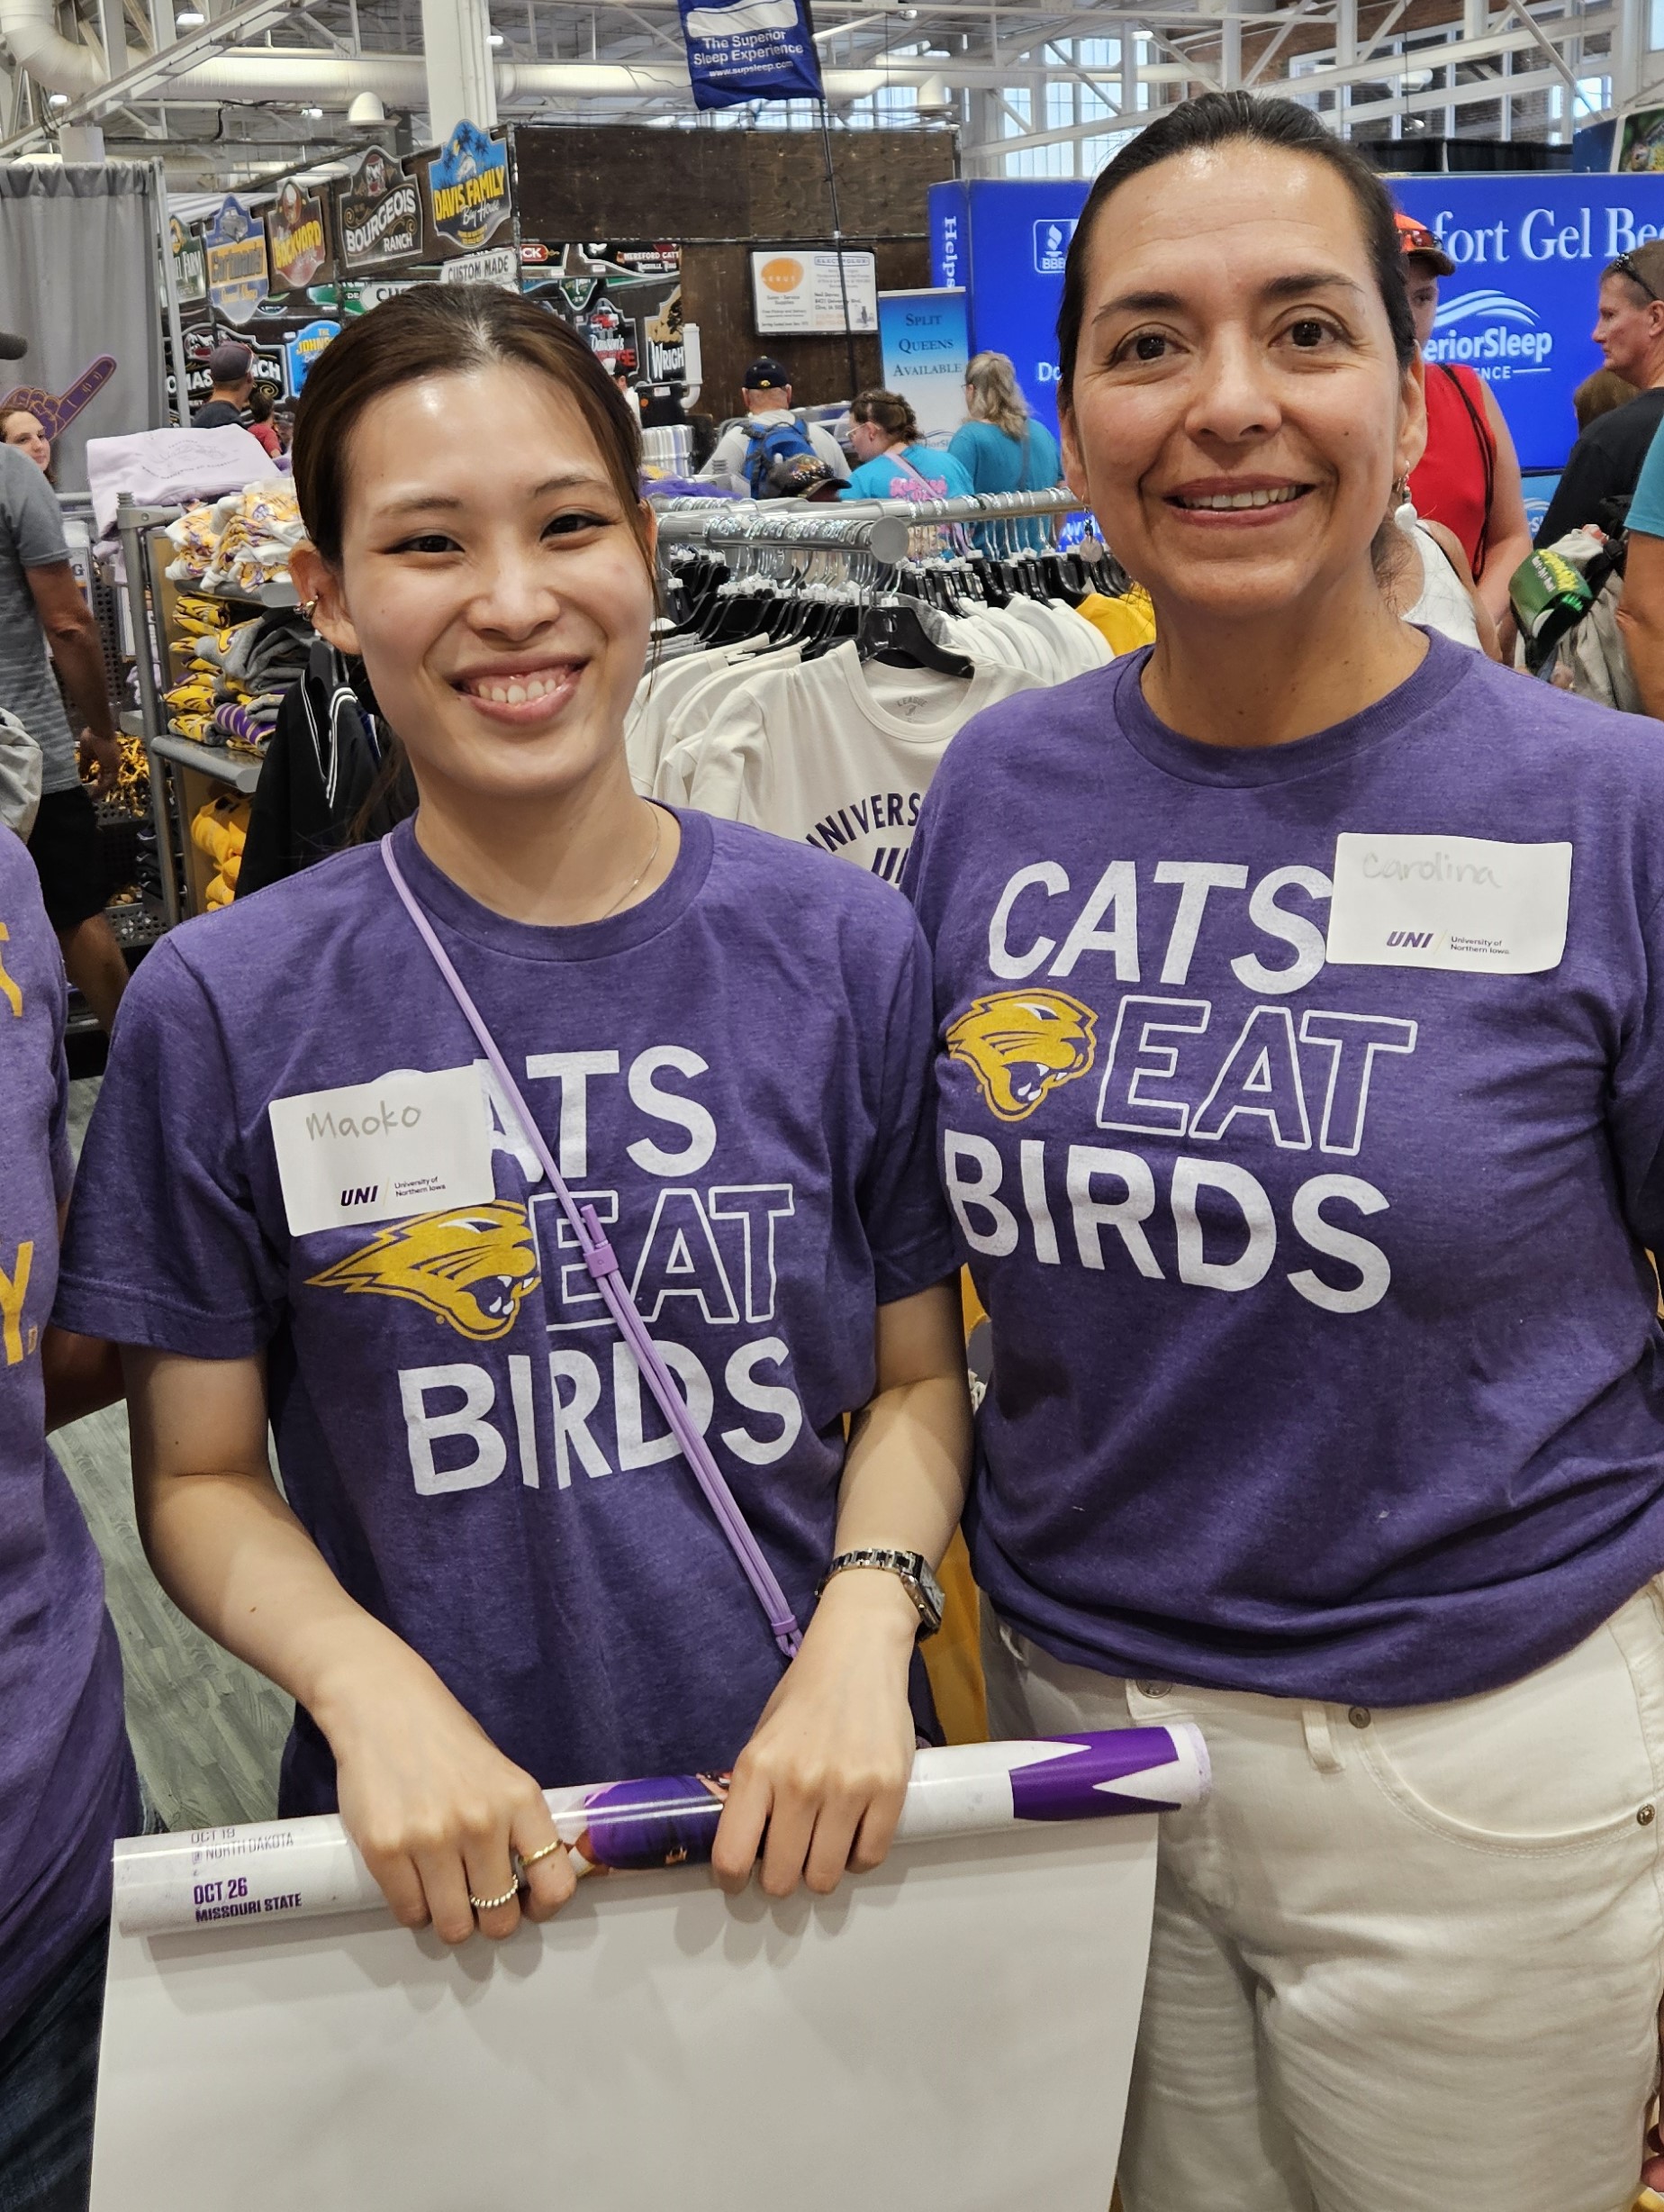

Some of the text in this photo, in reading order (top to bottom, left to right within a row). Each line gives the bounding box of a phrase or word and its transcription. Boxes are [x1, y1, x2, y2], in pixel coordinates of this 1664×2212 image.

[702, 31, 787, 50] The Superior
[693, 44, 804, 67] Sleep Experience
[709, 60, 794, 77] www.supsleep.com
[434, 165, 505, 221] DAVIS FAMILY
[346, 189, 417, 252] BOURGEOIS
[383, 232, 413, 252] RANCH
[1521, 207, 1593, 261] Gel
[943, 216, 959, 287] Helps
[448, 256, 510, 283] CUSTOM MADE
[905, 313, 944, 327] SPLIT
[899, 339, 954, 354] QUEENS
[893, 363, 963, 377] AVAILABLE
[1473, 366, 1512, 380] NCE
[897, 695, 928, 708] LEAGUE
[988, 860, 1334, 995] CATS
[1386, 930, 1434, 948] UNI
[1451, 937, 1493, 947] University
[1451, 944, 1511, 956] Northern Iowa
[1096, 994, 1418, 1156] EAT
[371, 1045, 718, 1183] ATS
[393, 1175, 439, 1190] University of
[395, 1183, 447, 1198] Northern Iowa
[340, 1184, 379, 1207] UNI
[945, 1128, 1392, 1314] BIRDS
[528, 1183, 796, 1332] EAT
[397, 1336, 803, 1496] BIRDS
[191, 1829, 217, 1845] OCT
[205, 1840, 246, 1862] NORTH
[249, 1831, 294, 1854] DAKOTA
[194, 1876, 249, 1905] OCT 26
[194, 1892, 303, 1923] MISSOURI STATE
